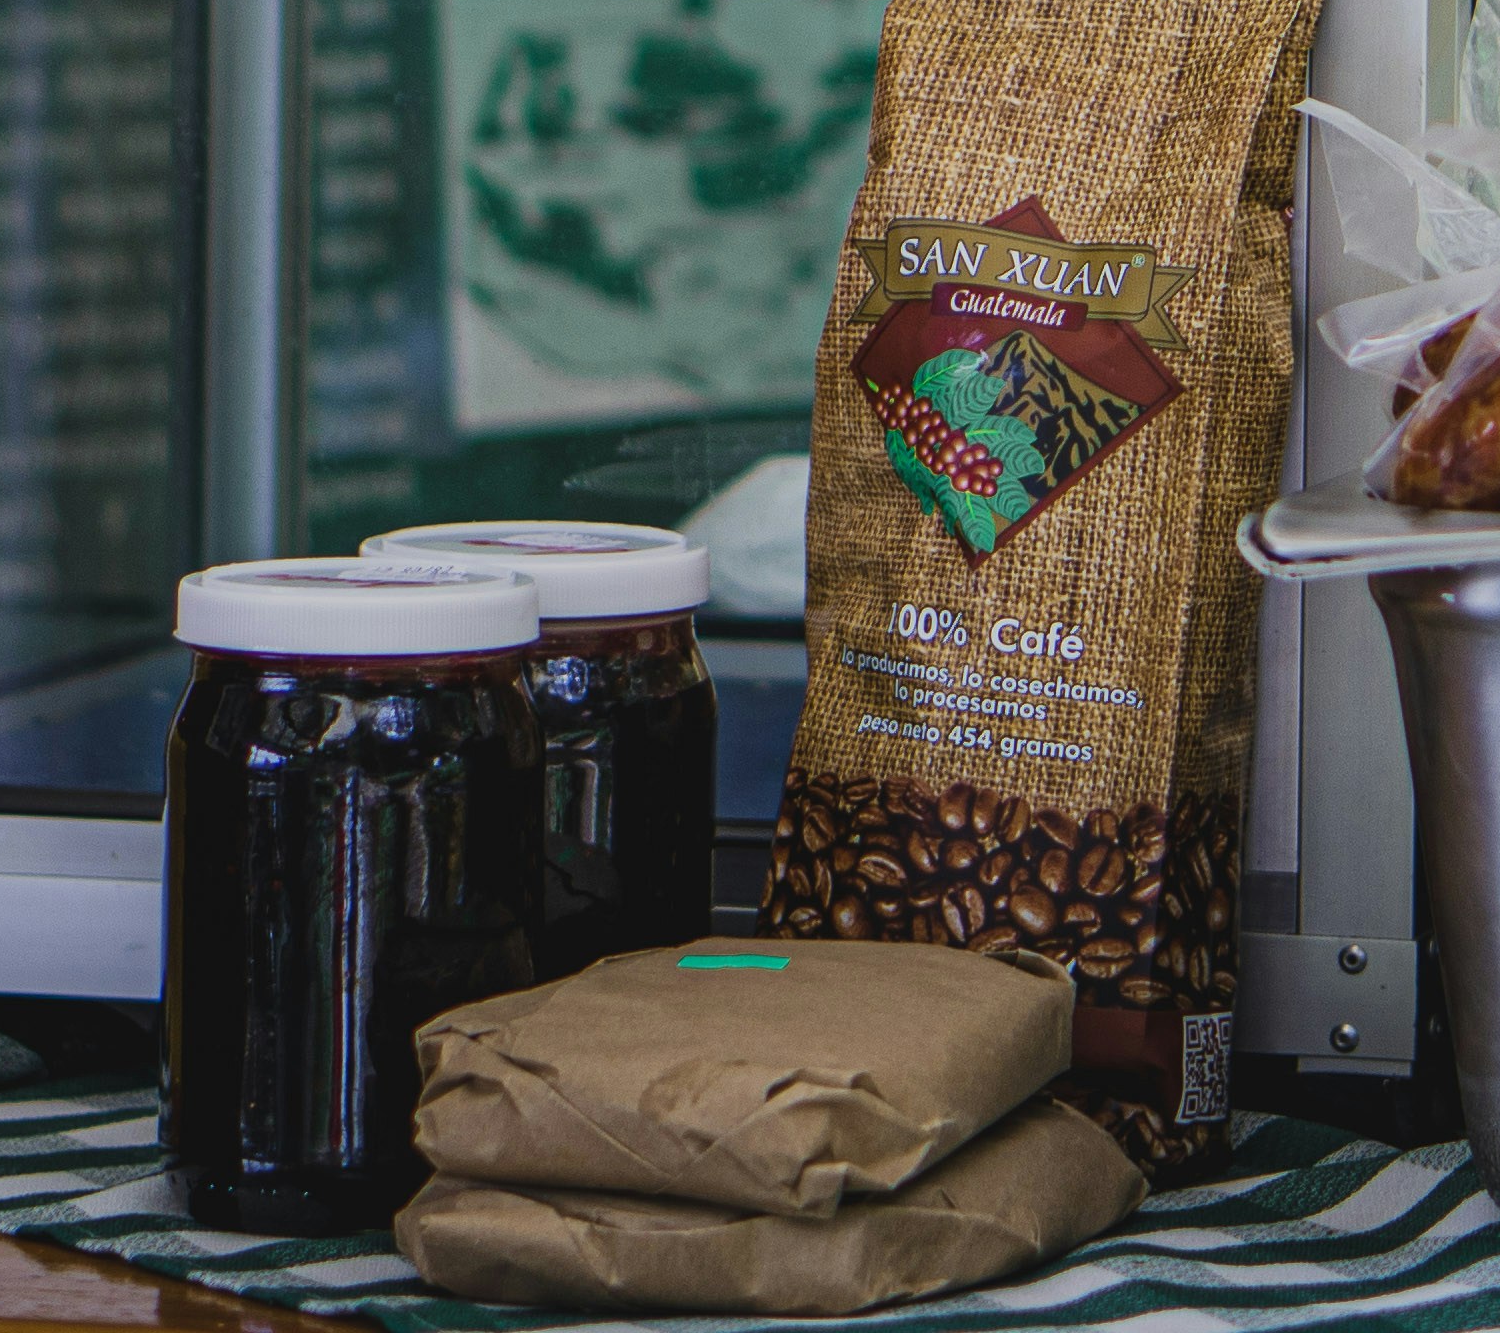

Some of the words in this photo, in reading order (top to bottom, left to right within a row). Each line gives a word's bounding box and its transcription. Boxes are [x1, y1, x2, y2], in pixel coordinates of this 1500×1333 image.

[899, 237, 988, 277] SAN
[997, 249, 1130, 298] XUAN
[950, 289, 1067, 327] Guatemala
[887, 602, 968, 647] 100%
[990, 618, 1085, 661] Café
[841, 643, 855, 666] lo
[857, 650, 955, 687] producimos,
[961, 664, 983, 689] lo
[990, 674, 1145, 710] cosechamos,
[894, 678, 909, 701] lo
[912, 687, 1048, 721] procesamos
[857, 713, 899, 735] peso
[902, 720, 941, 745] neto
[947, 724, 993, 751] 454
[1000, 736, 1094, 763] gramos
